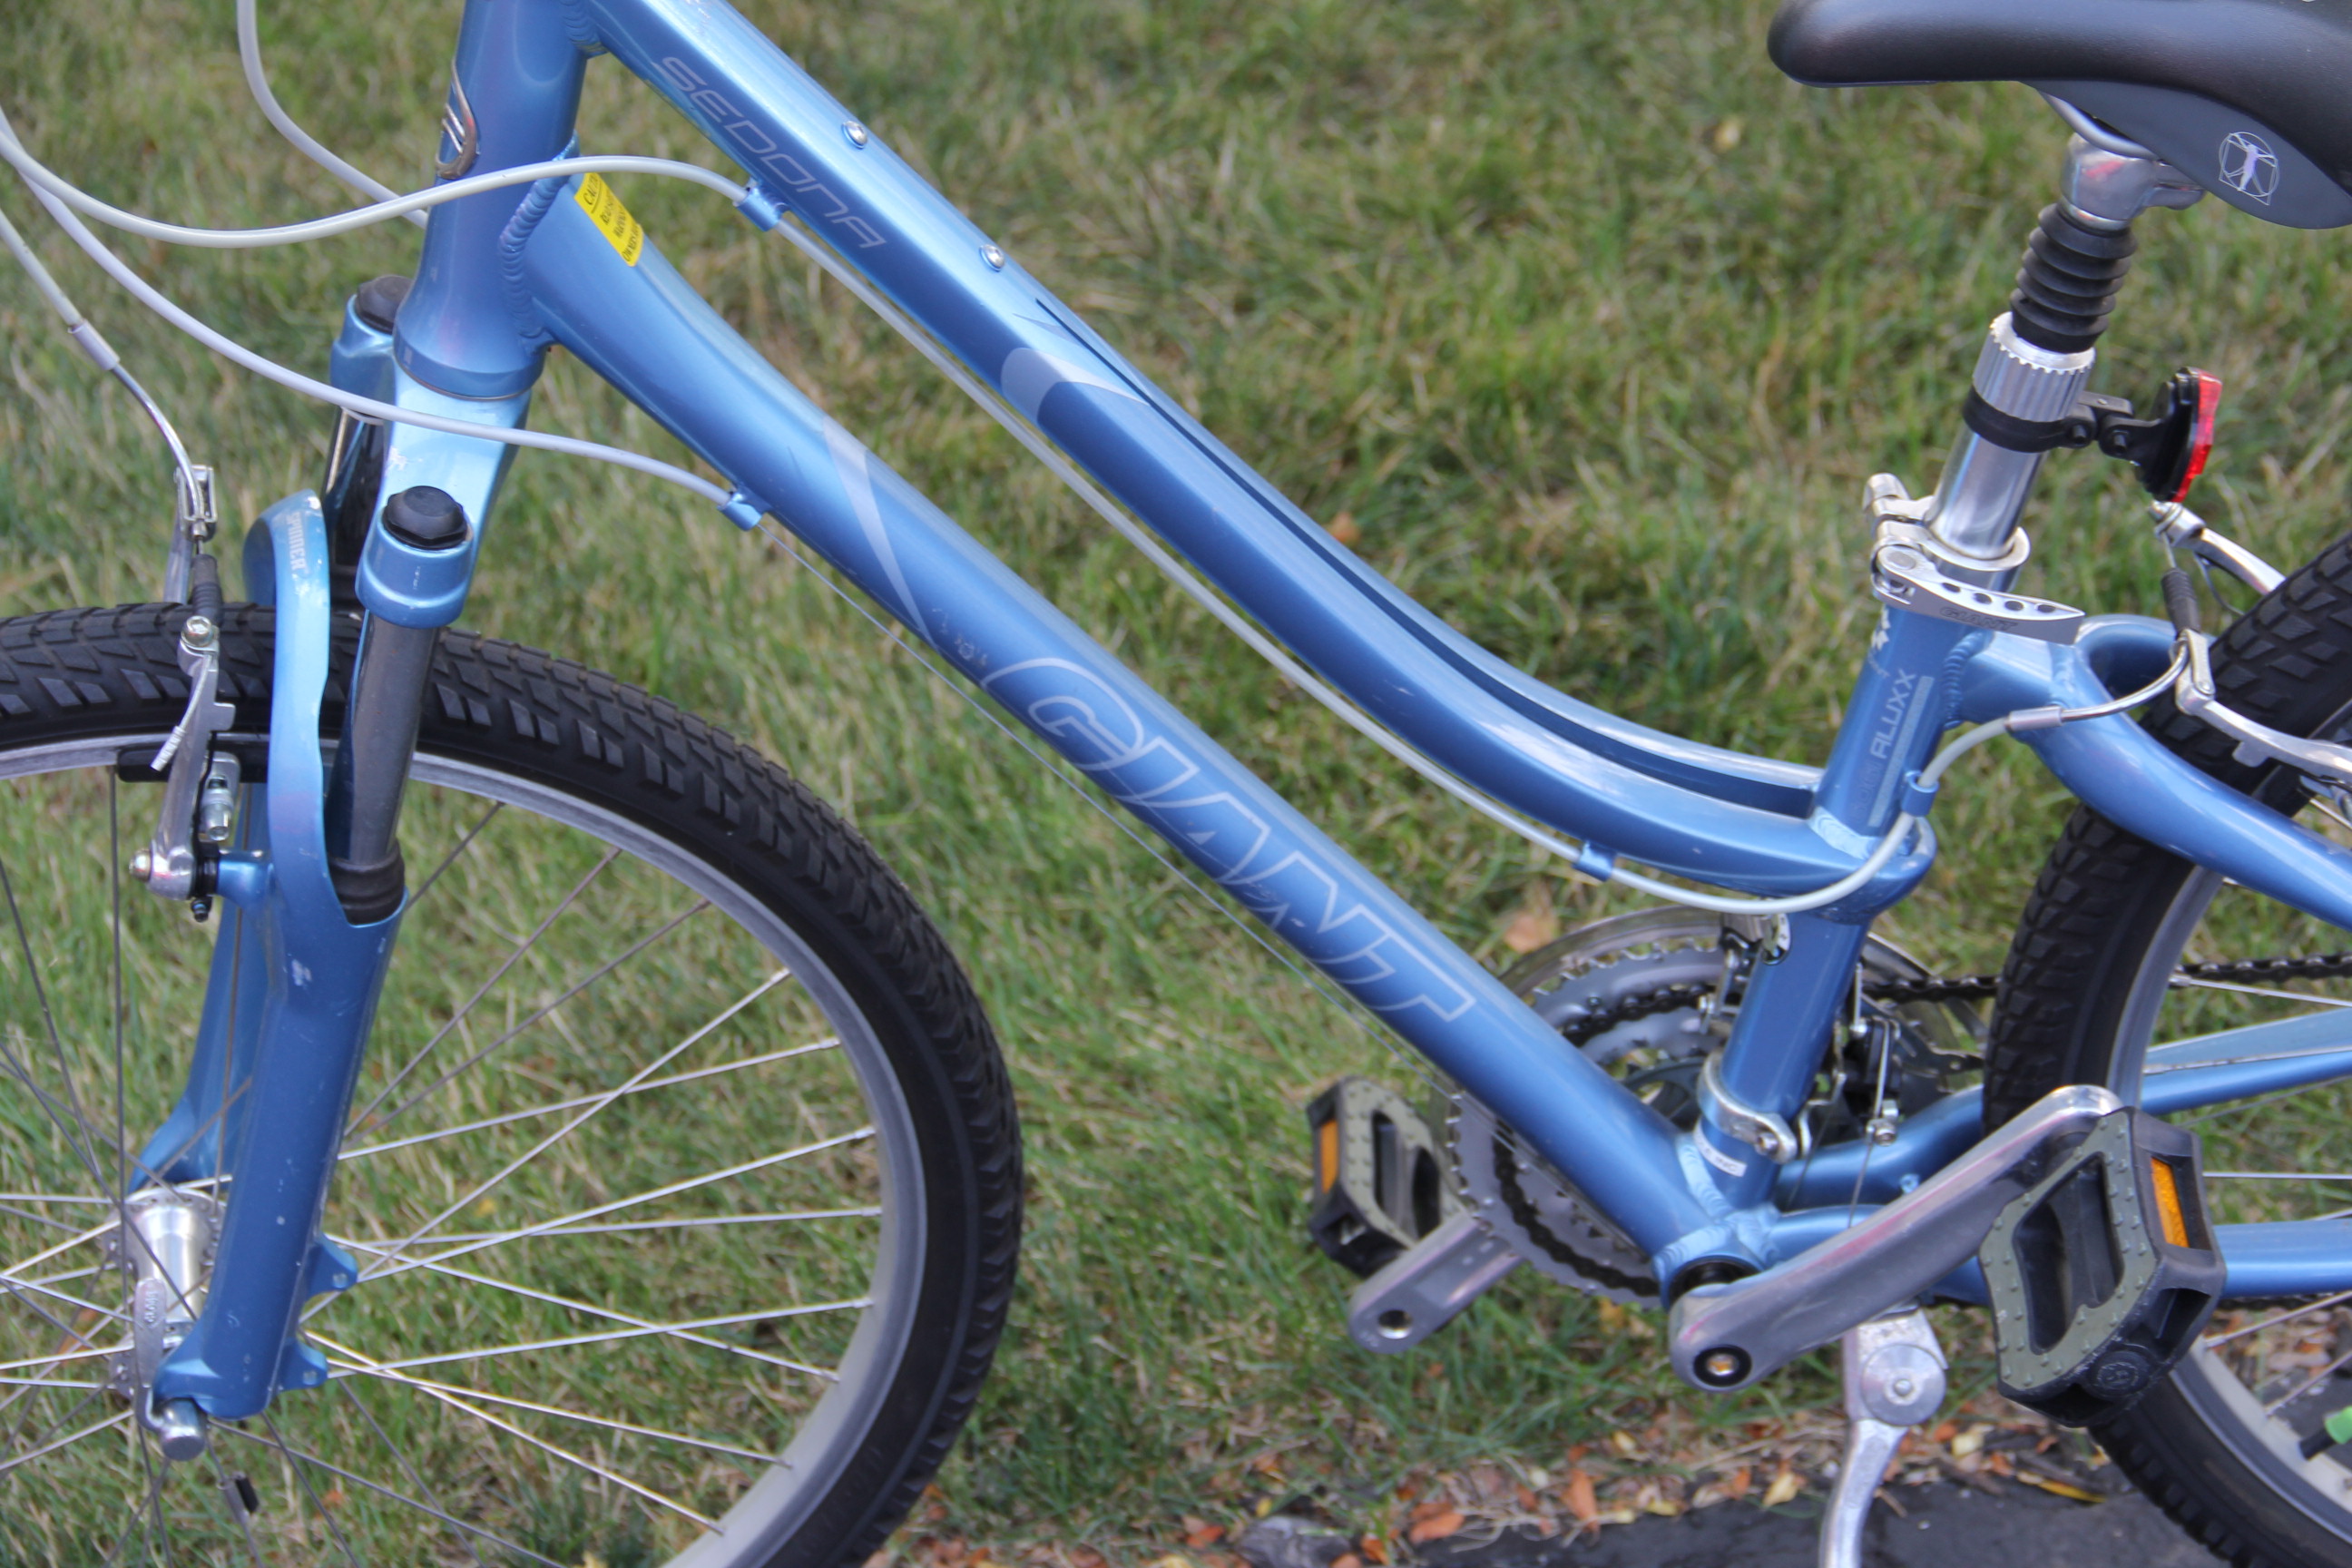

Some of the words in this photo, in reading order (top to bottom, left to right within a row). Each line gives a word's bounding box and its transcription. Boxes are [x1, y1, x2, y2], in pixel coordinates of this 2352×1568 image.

[652, 56, 887, 248] SEDONA
[1870, 669, 1916, 760] ALUXX
[981, 656, 1476, 1022] GIANT
